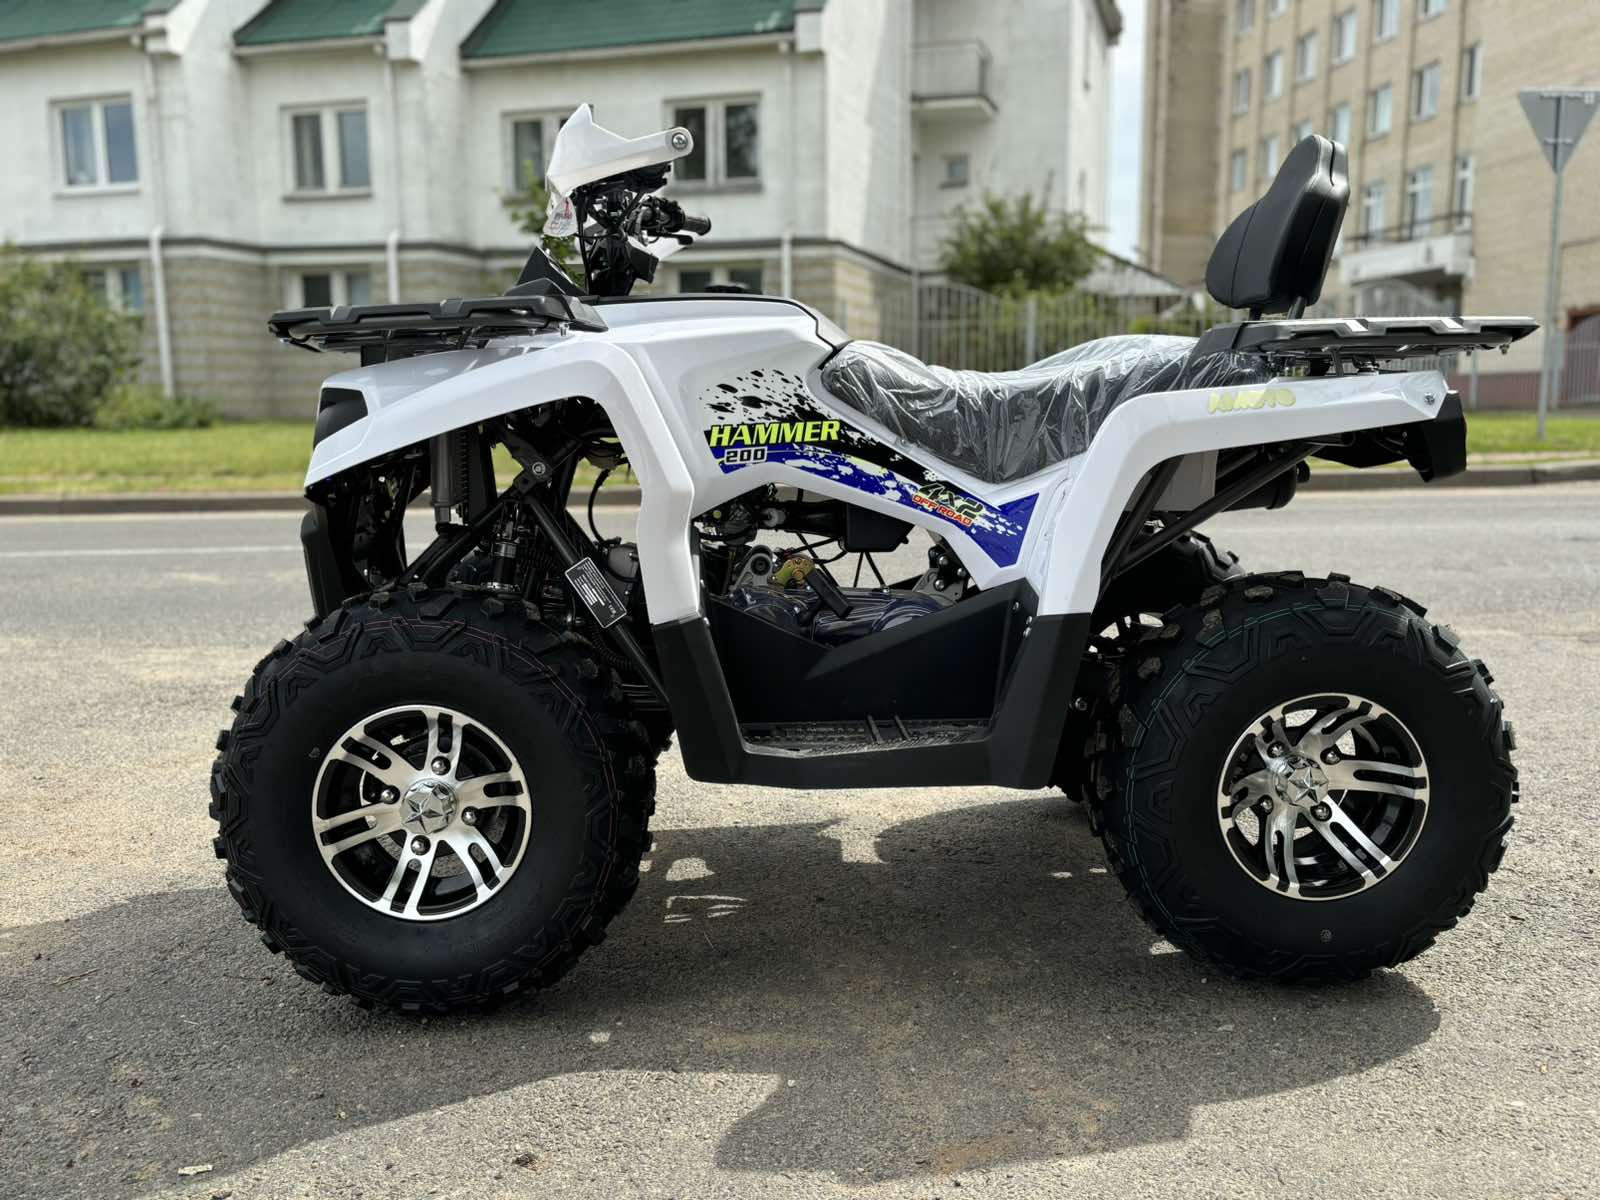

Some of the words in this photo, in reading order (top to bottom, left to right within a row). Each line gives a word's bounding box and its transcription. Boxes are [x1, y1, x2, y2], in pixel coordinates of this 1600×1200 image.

[709, 419, 841, 448] HAMMER
[725, 447, 767, 464] 200
[912, 493, 939, 510] OFF
[936, 504, 974, 527] ROAD
